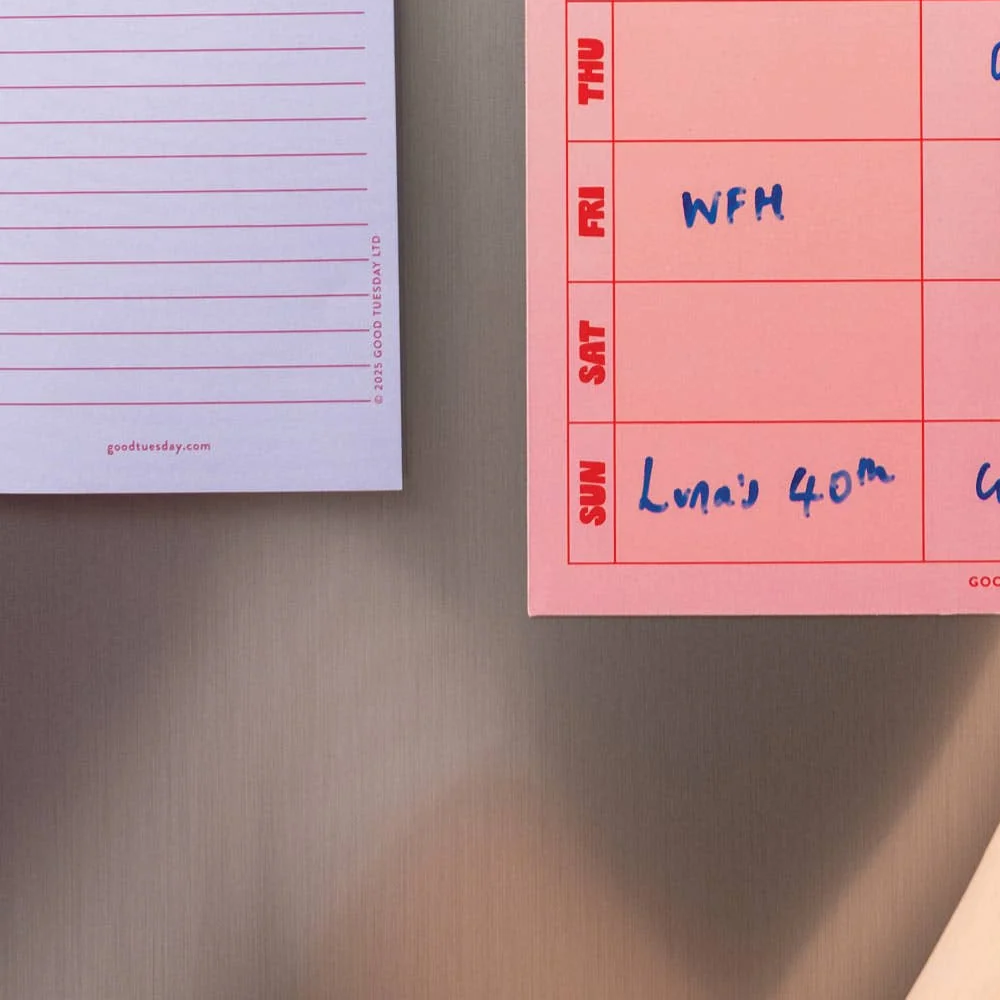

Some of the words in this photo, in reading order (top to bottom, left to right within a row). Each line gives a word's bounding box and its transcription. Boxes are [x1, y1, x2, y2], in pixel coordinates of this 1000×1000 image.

[577, 37, 605, 106] THU
[577, 186, 606, 238] FRI
[681, 183, 785, 229] WFH
[371, 235, 382, 257] LTD
[371, 261, 382, 317] TUESDAY
[372, 320, 383, 359] GOOD
[578, 319, 606, 386] SAT
[373, 362, 384, 391] 2025
[107, 440, 211, 456] goodtuesday.com
[579, 460, 607, 527] SUN
[638, 455, 760, 515] Luna's
